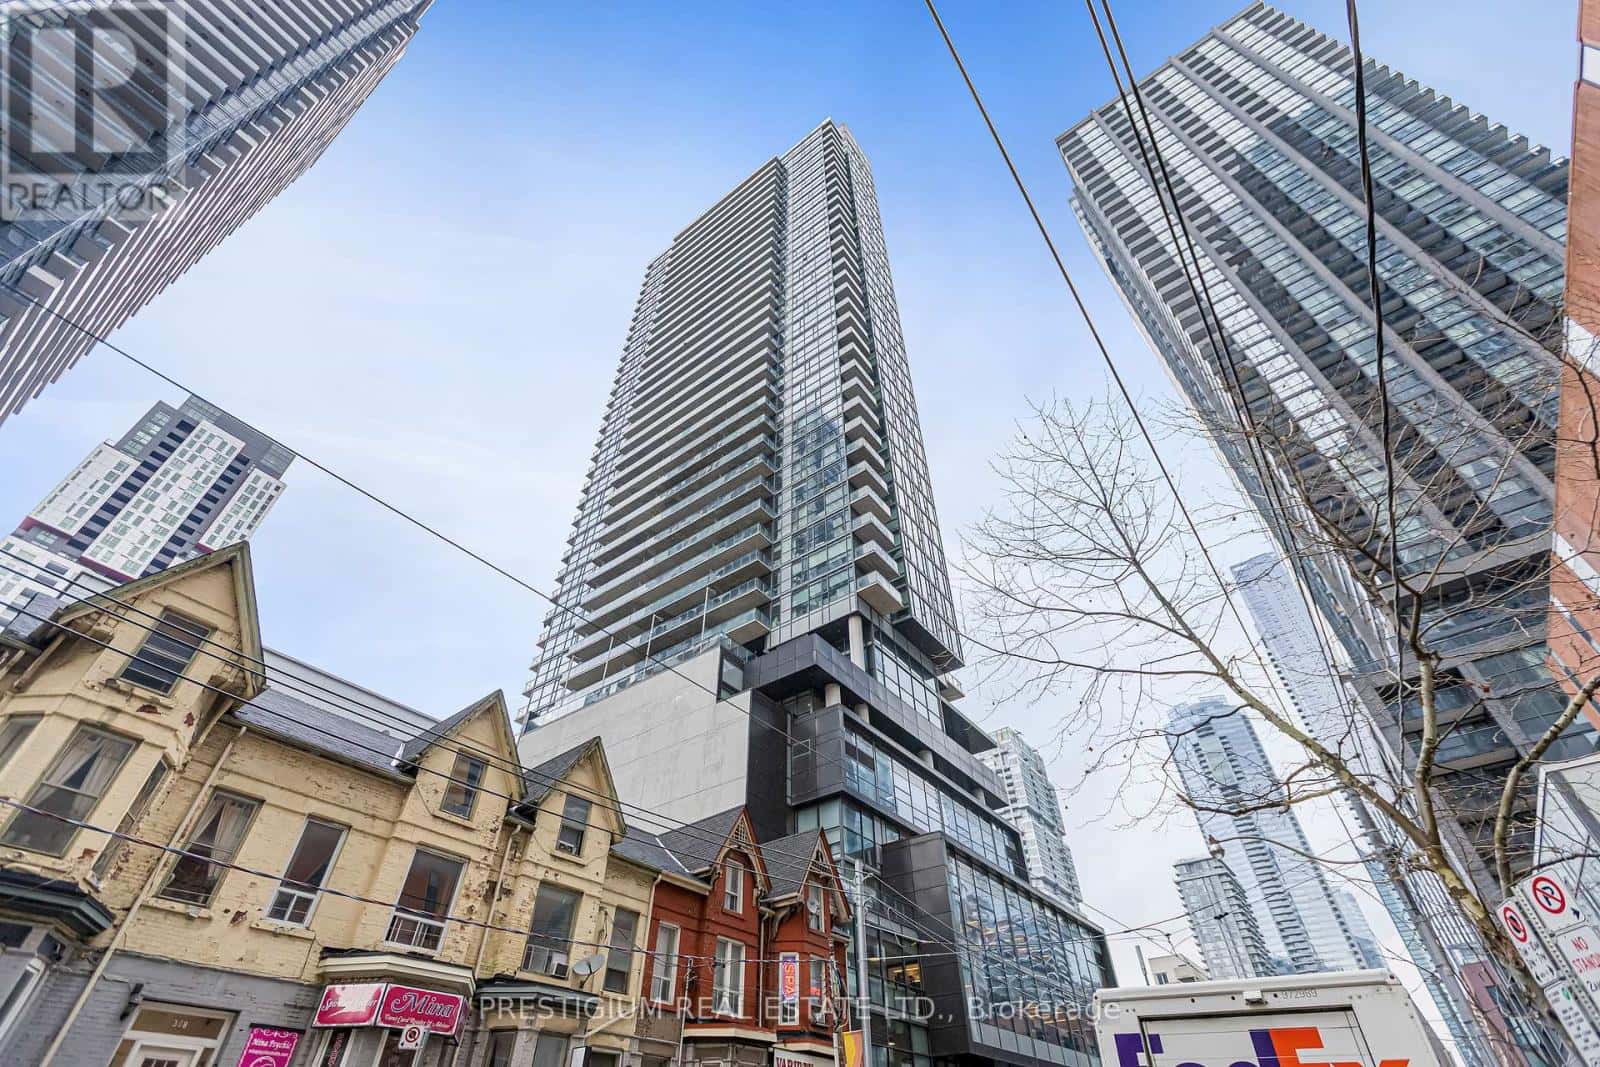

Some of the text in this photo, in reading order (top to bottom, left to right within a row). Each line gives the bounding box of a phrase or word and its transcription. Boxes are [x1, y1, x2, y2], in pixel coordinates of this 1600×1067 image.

[1571, 936, 1588, 954] NO
[784, 962, 796, 998] SPA
[391, 992, 455, 1018] Mina
